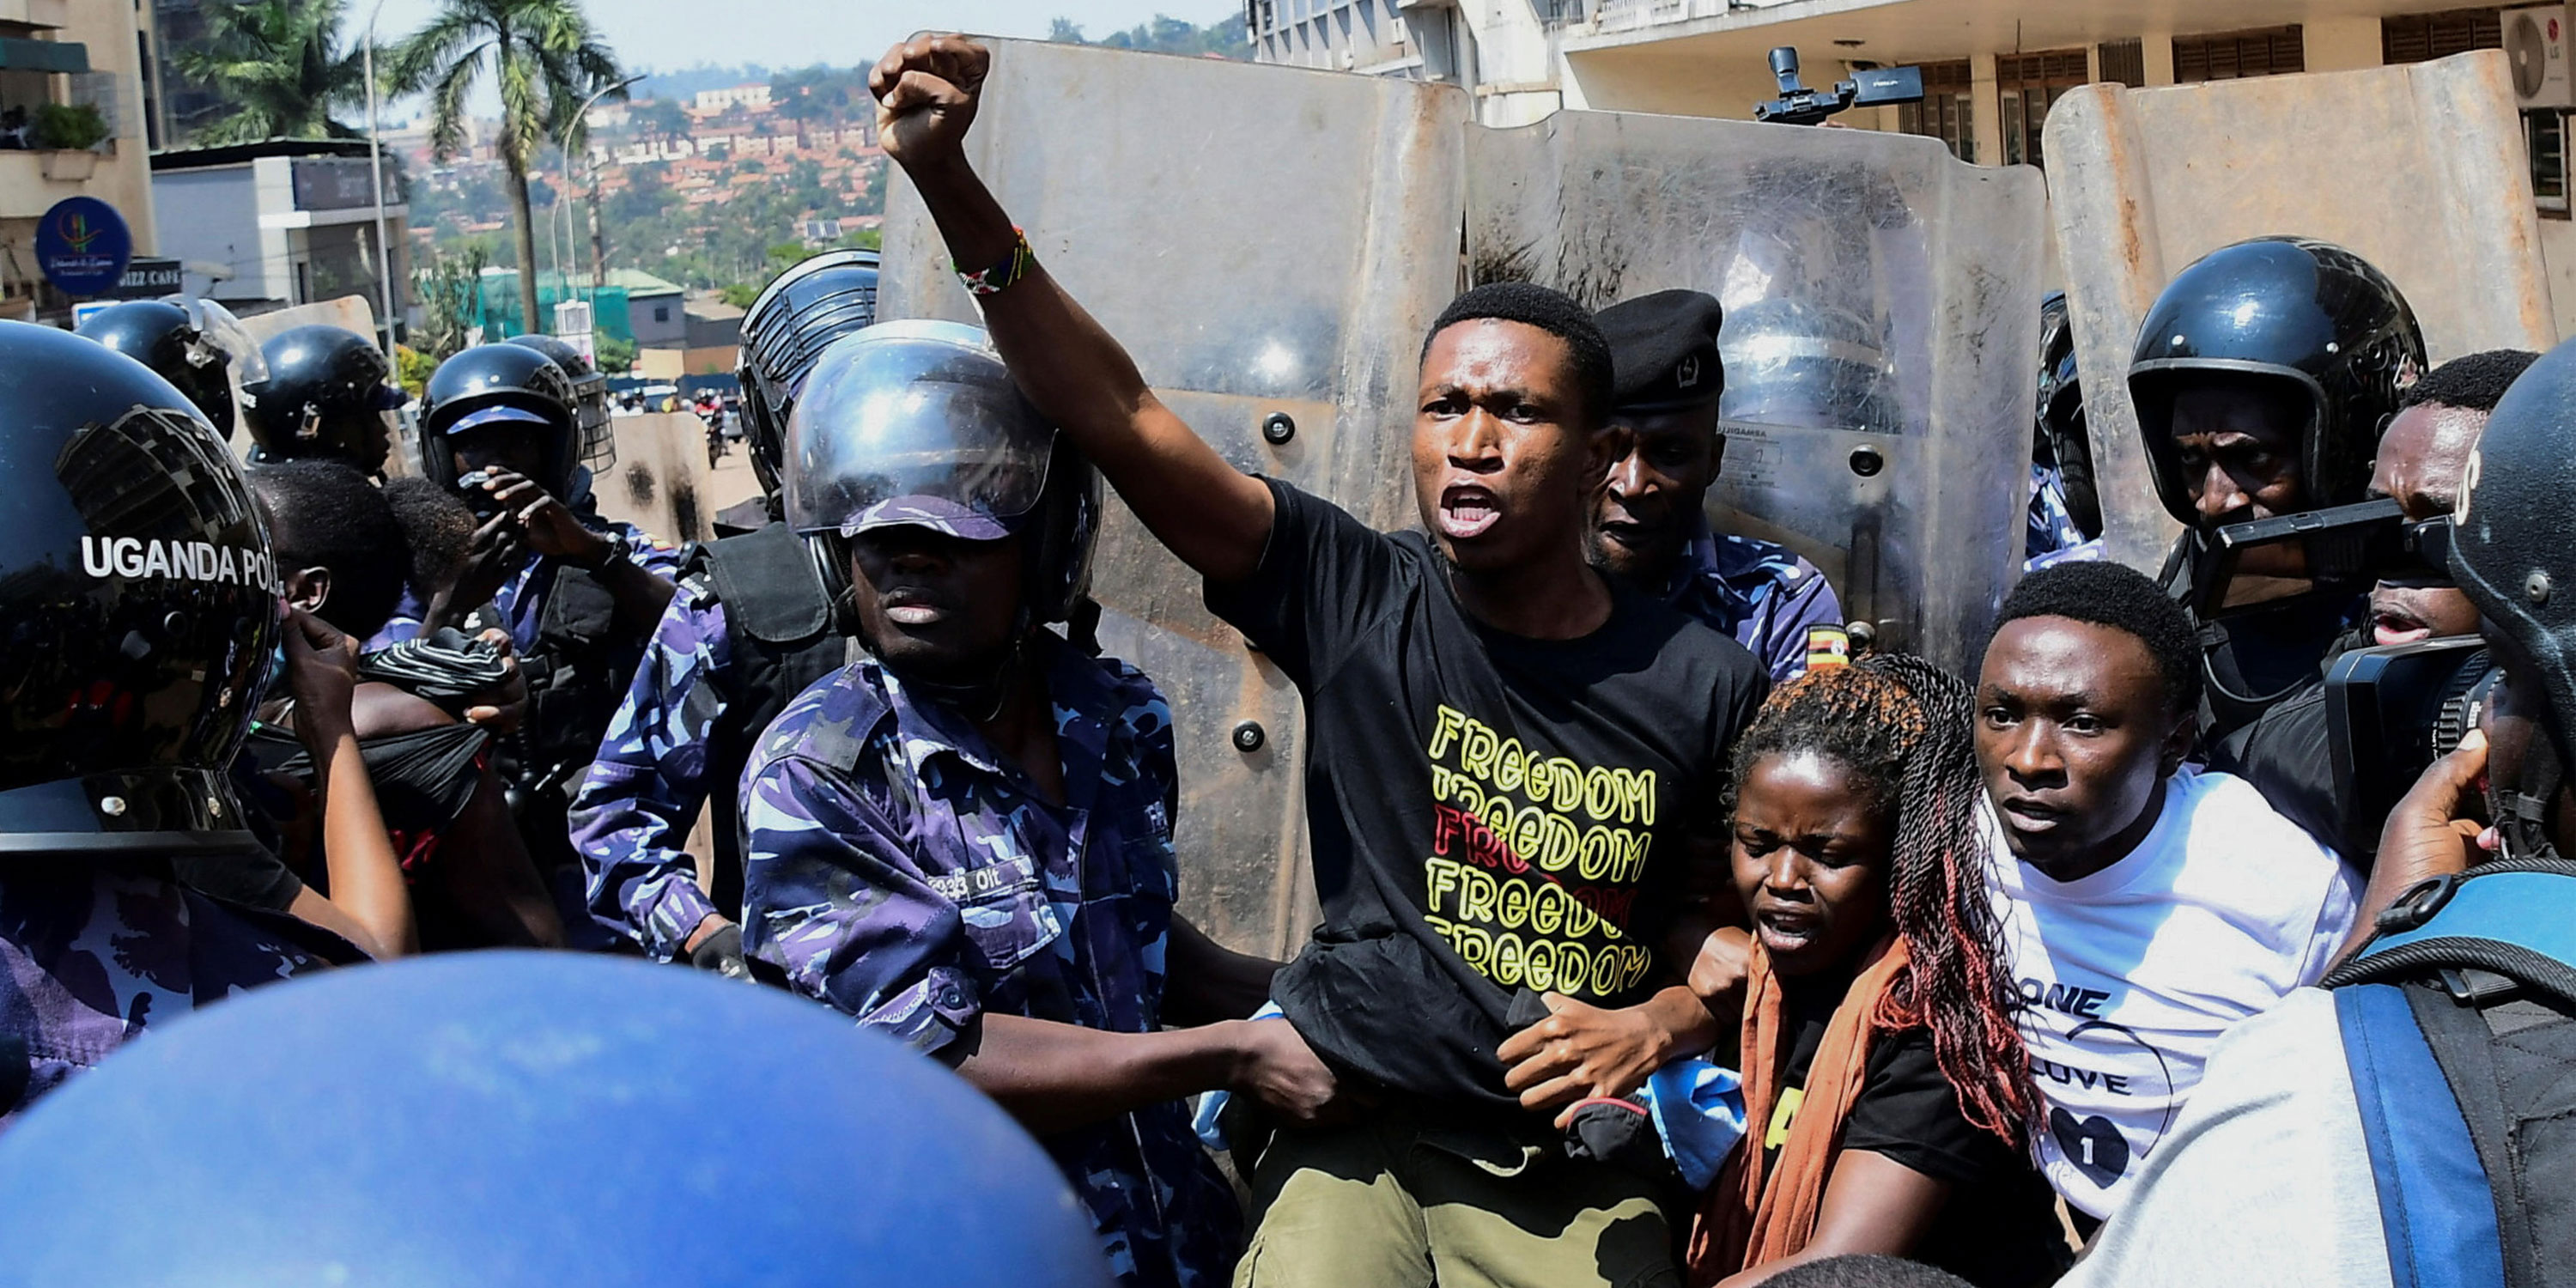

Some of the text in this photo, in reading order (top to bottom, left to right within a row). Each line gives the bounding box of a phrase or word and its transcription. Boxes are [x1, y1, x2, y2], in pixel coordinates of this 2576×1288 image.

[82, 536, 279, 594] UGANDA POL
[2018, 977, 2111, 1020] ONE
[2080, 1136, 2094, 1165] 1
